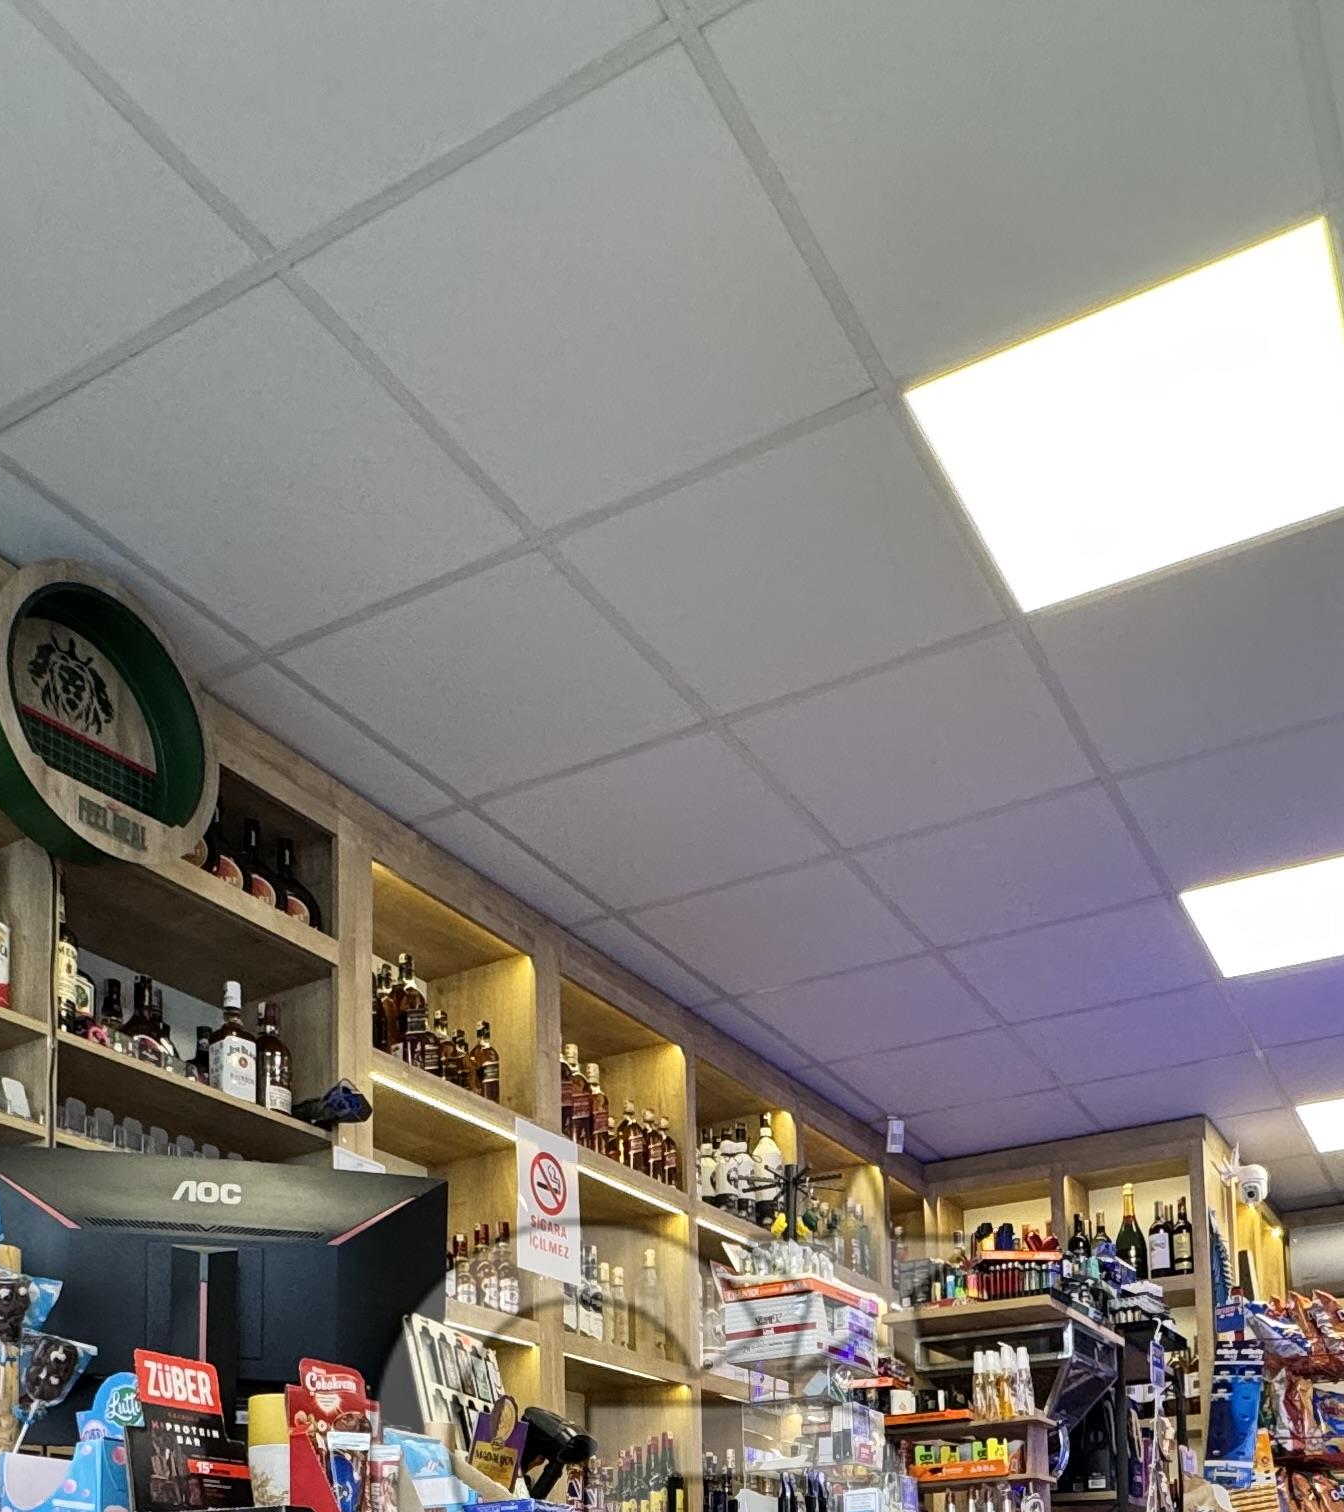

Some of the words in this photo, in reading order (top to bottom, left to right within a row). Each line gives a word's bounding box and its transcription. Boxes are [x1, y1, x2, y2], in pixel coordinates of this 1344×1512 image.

[172, 1180, 242, 1205] AOC
[144, 1360, 215, 1407] ZÜBER
[166, 1421, 220, 1439] PROTEIN
[176, 1435, 201, 1447] BAR
